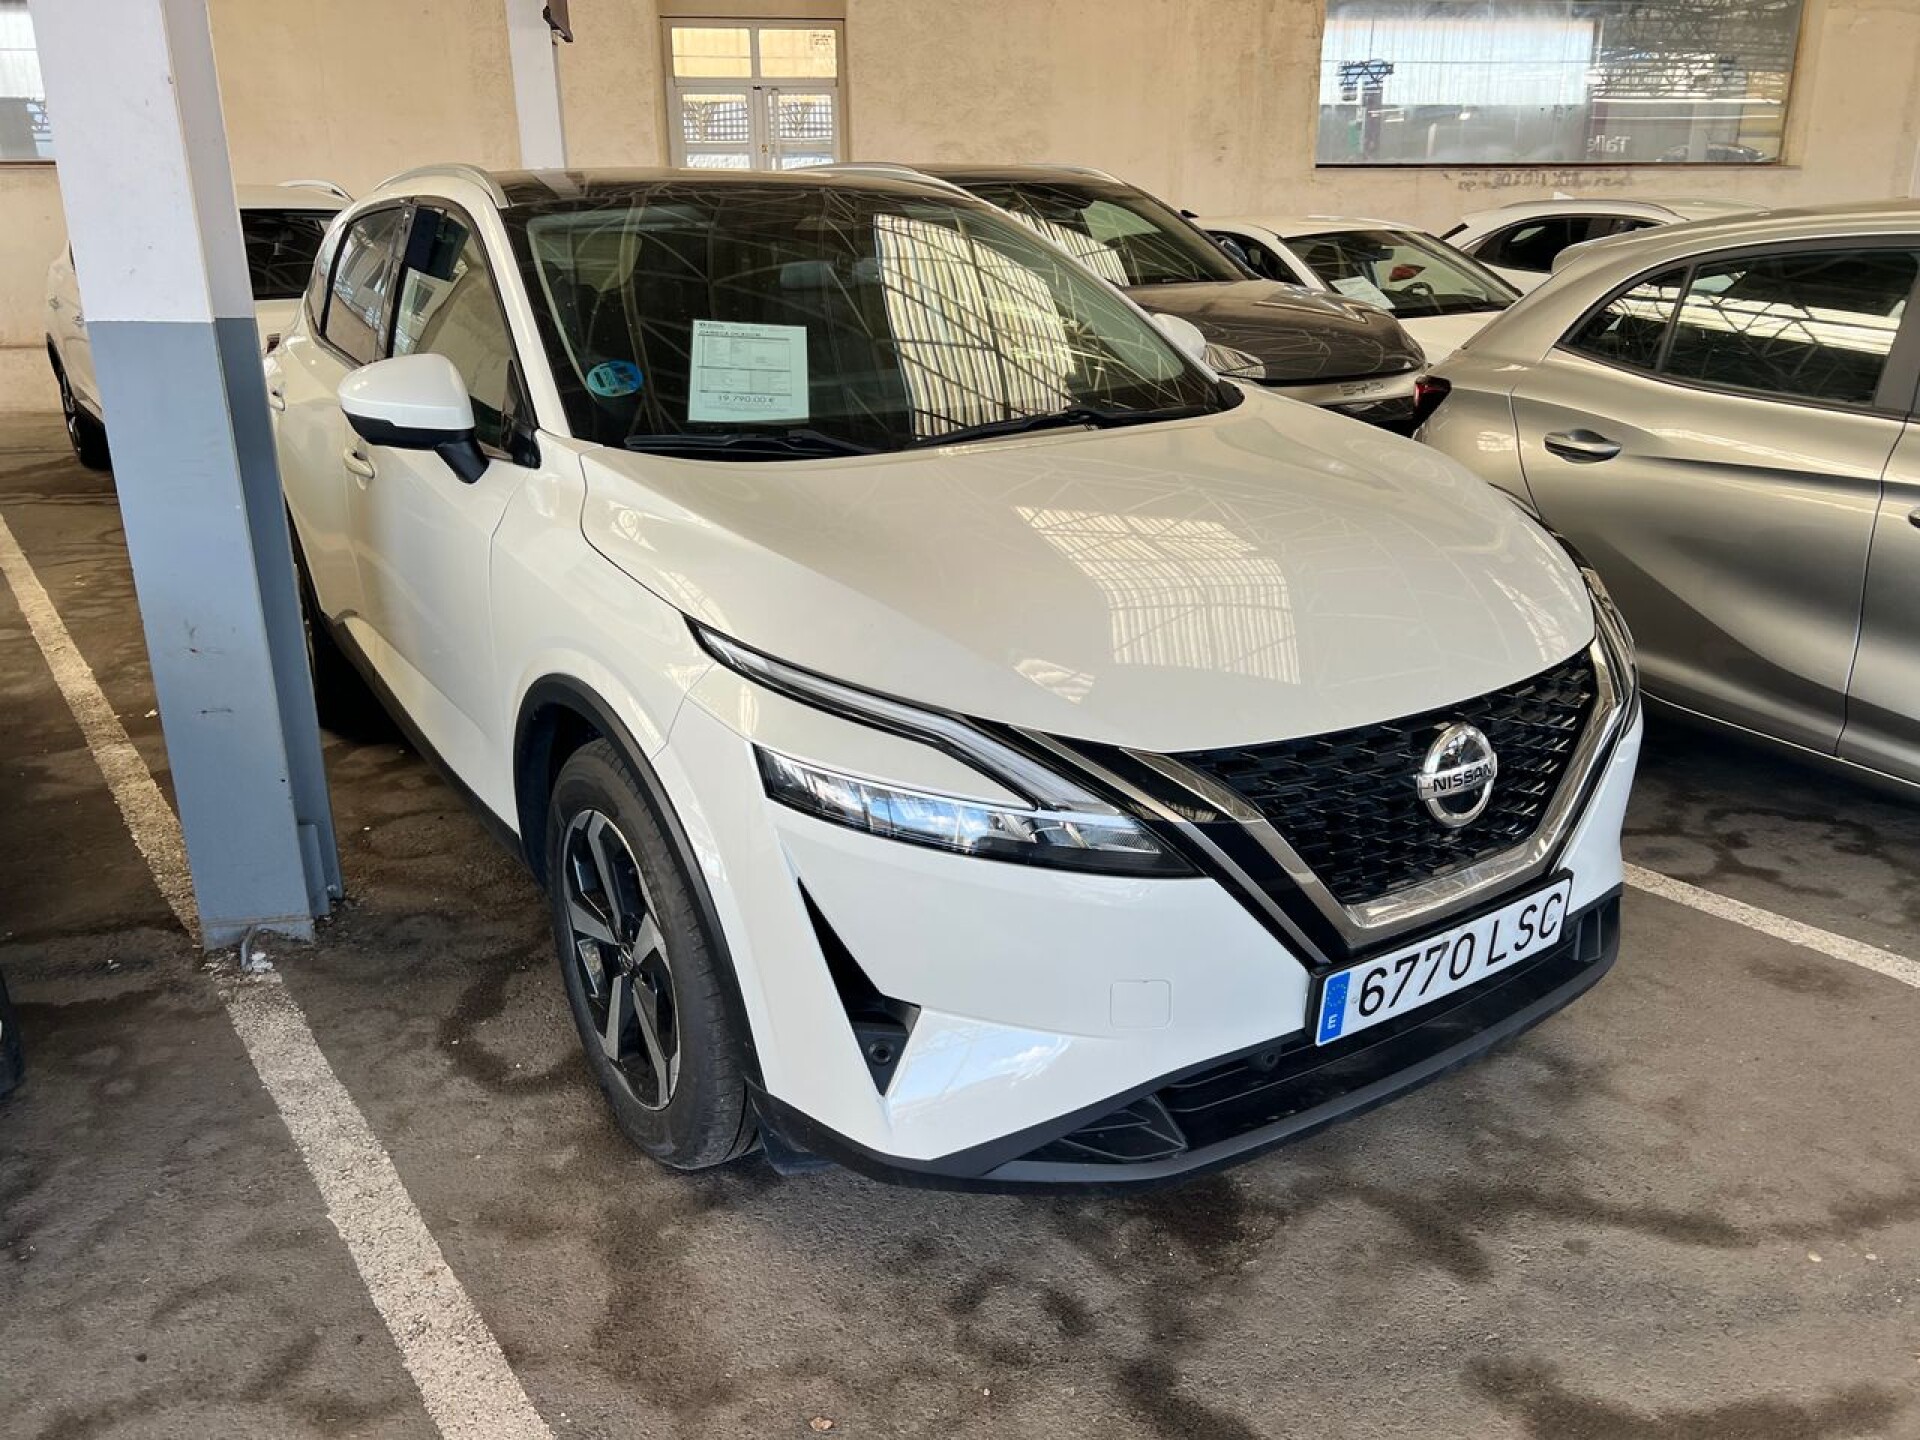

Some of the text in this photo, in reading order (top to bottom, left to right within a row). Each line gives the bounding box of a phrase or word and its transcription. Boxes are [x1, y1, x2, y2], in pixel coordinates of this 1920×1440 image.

[1433, 764, 1491, 792] NISSAN
[1358, 892, 1562, 1017] 6770 LSC
[1327, 1013, 1338, 1030] E
